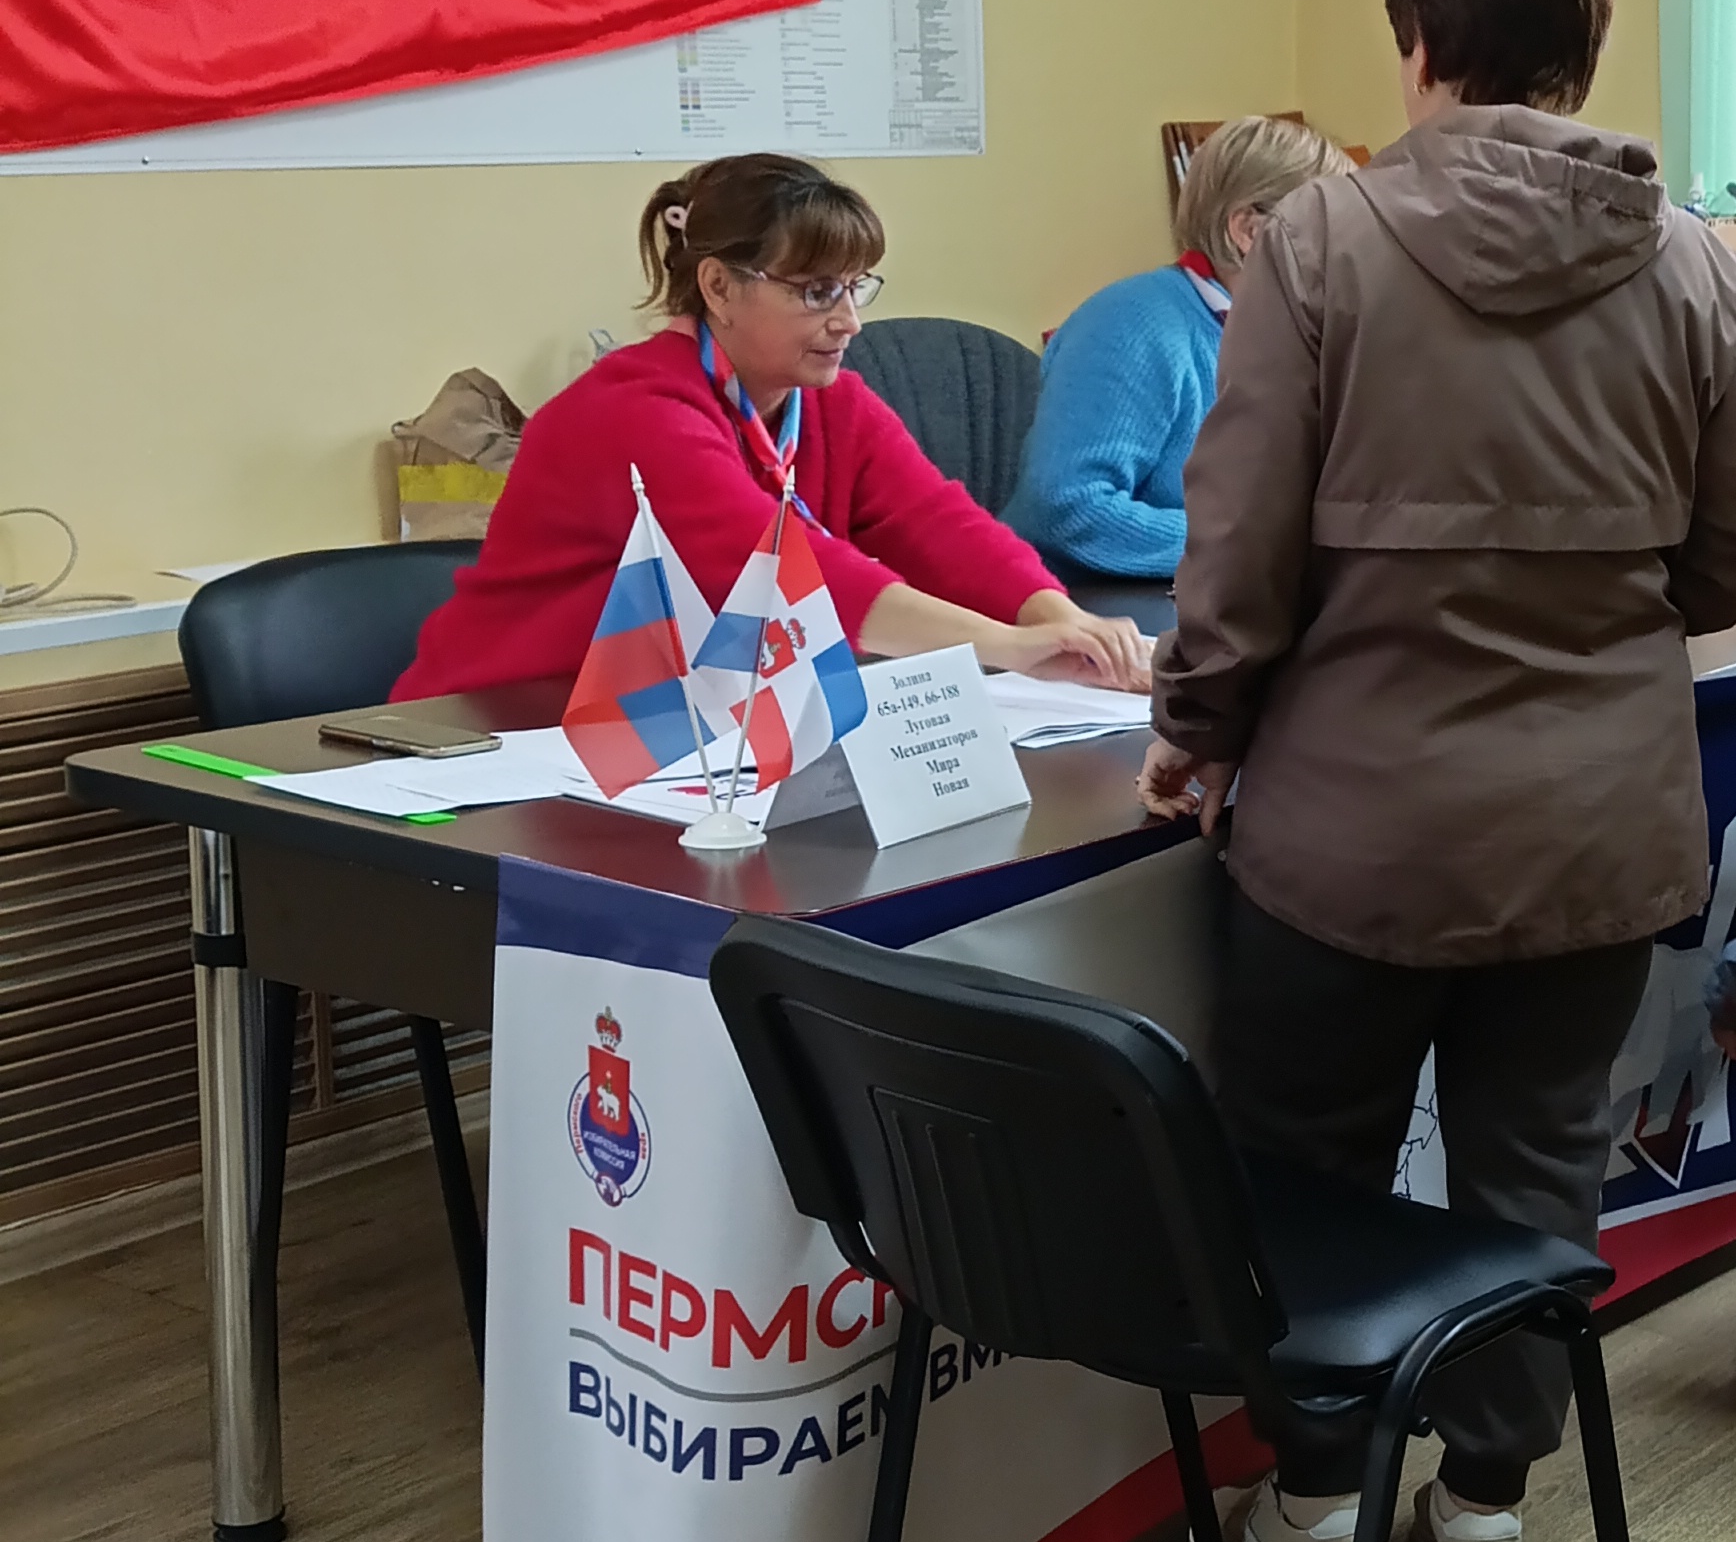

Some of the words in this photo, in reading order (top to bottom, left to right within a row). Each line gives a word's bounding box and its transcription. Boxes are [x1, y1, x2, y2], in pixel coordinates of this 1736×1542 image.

[889, 671, 932, 690] Золина
[924, 684, 960, 704] 66-188
[904, 712, 951, 736] Луговая
[890, 728, 979, 762] Механизаторов
[926, 757, 961, 775] Мира
[932, 776, 970, 797] Новая
